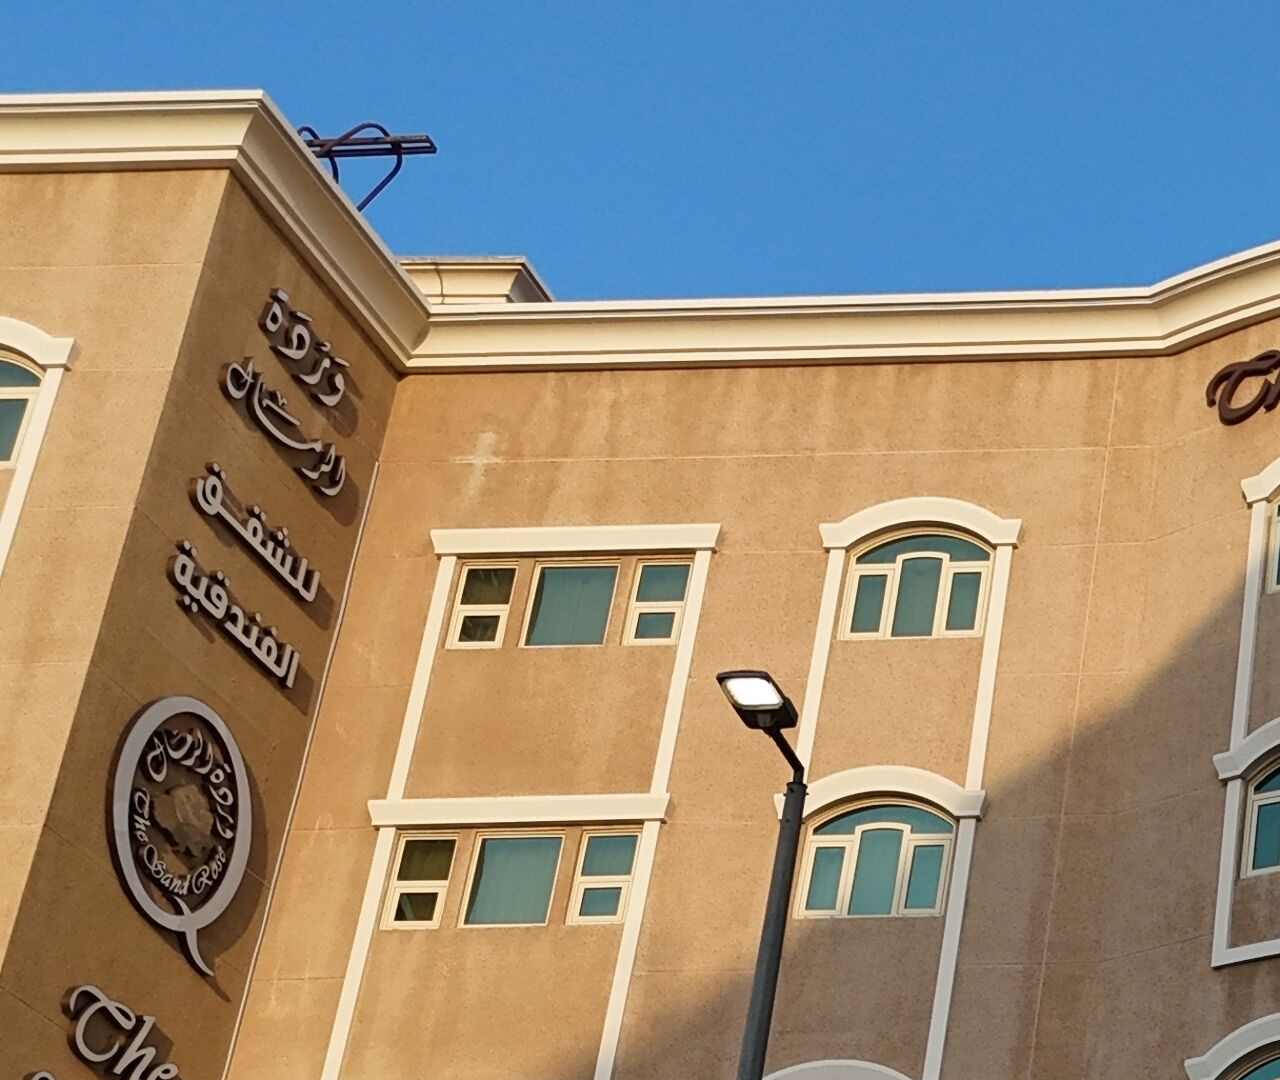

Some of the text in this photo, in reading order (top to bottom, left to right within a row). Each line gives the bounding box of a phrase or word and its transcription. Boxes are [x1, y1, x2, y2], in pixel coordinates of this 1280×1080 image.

[193, 462, 320, 602] للشقق
[171, 540, 300, 689] الفندقية
[143, 844, 191, 896] Sand
